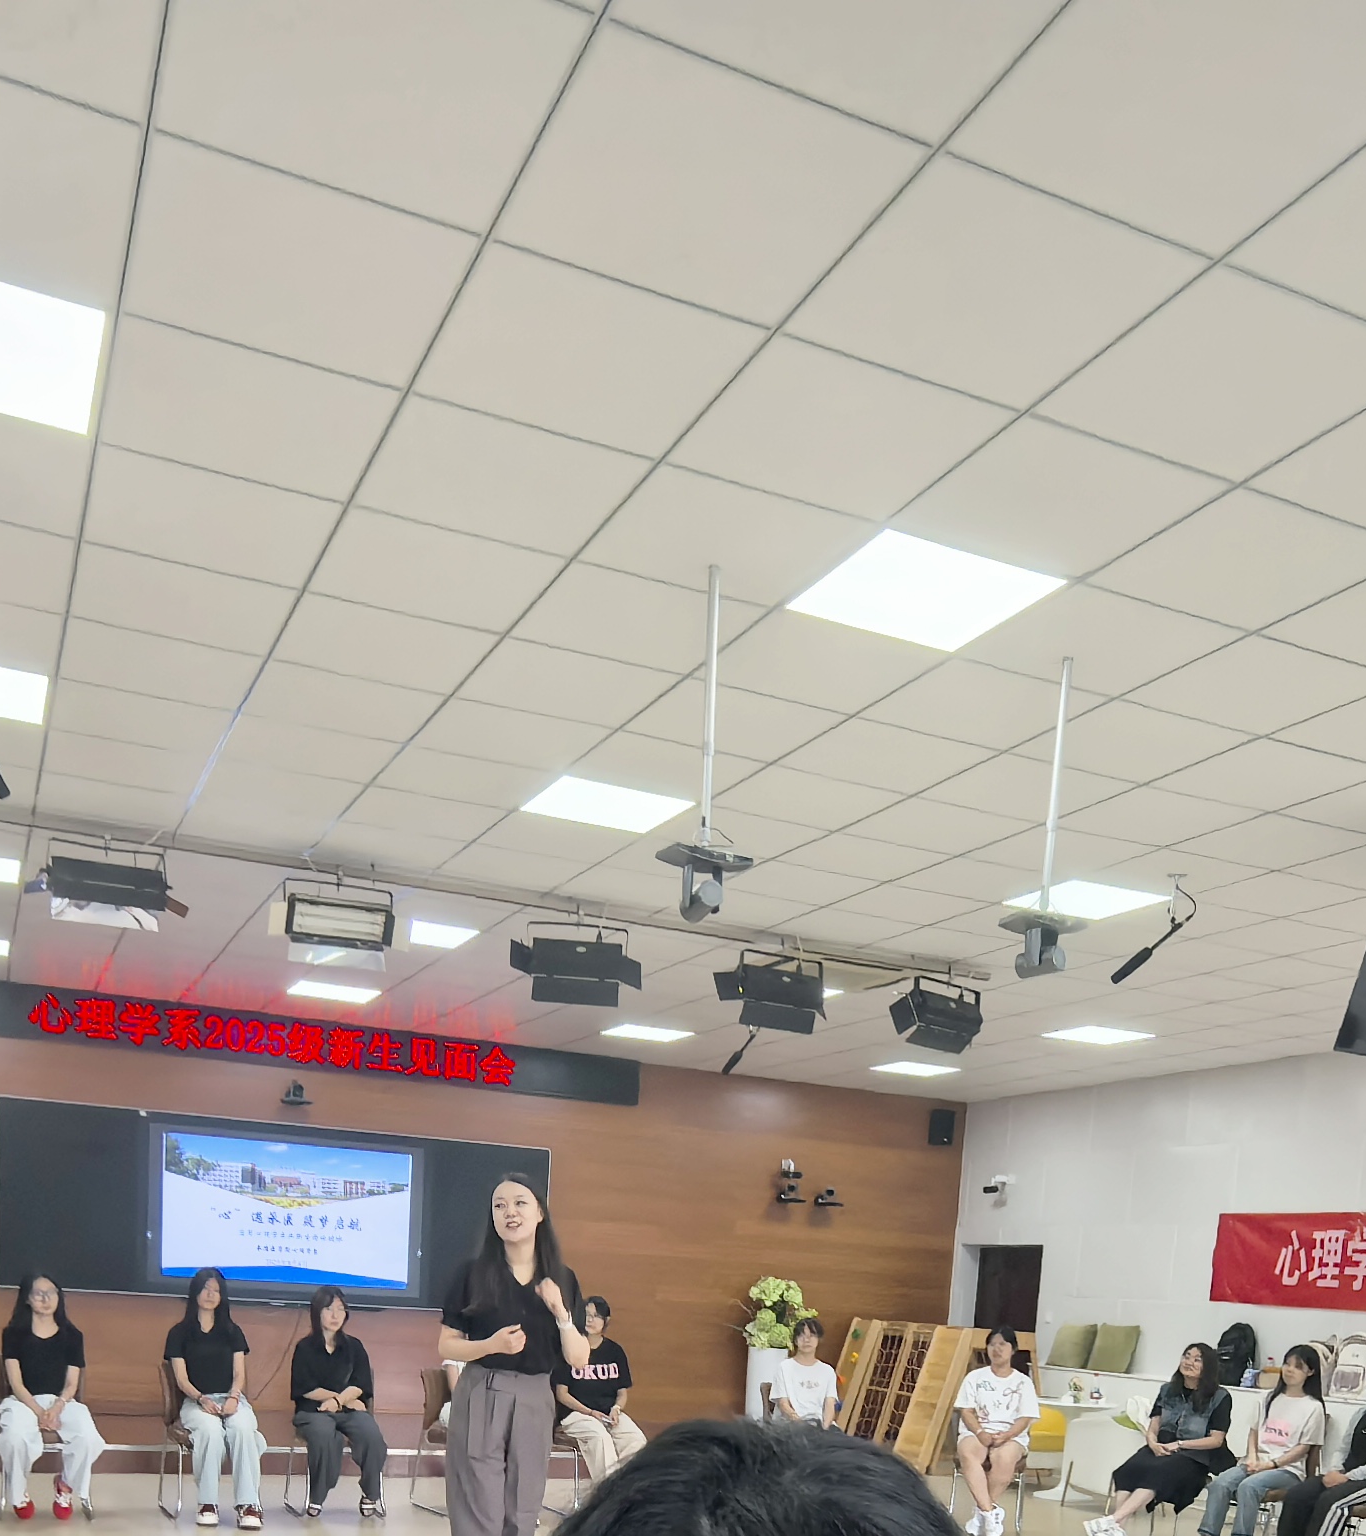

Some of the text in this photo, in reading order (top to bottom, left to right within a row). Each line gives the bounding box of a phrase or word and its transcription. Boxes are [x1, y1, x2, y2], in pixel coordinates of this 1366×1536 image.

[28, 992, 516, 1087] 心理学系2025级新生见面会
